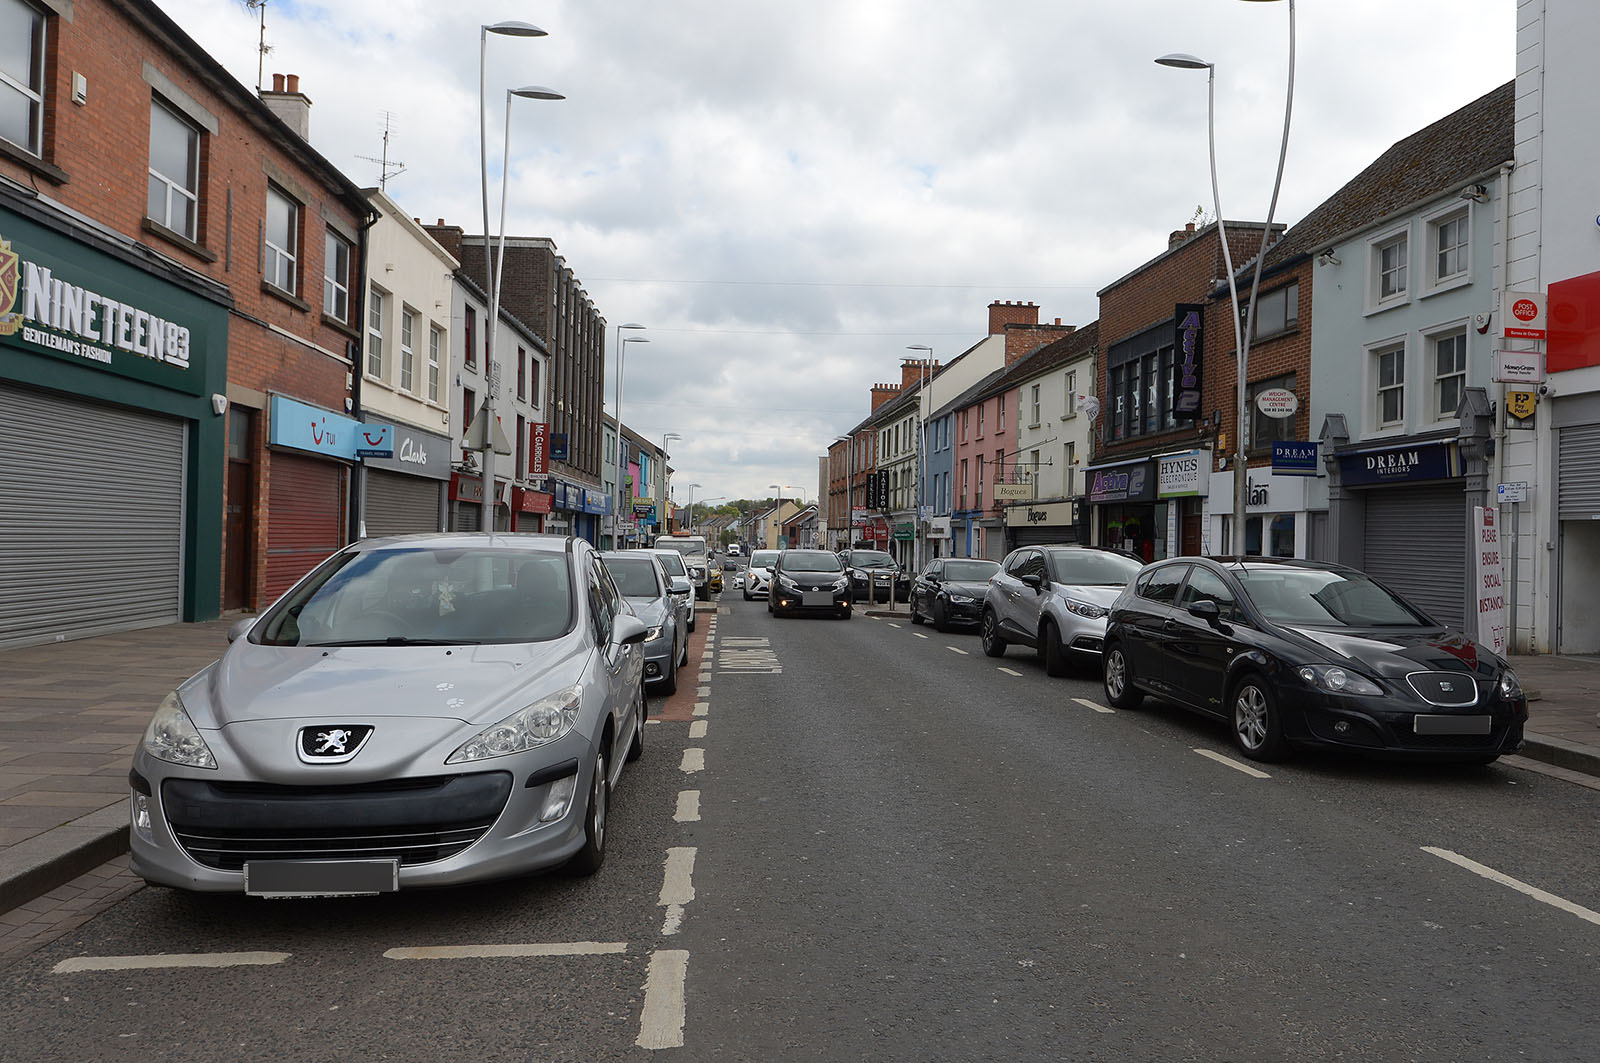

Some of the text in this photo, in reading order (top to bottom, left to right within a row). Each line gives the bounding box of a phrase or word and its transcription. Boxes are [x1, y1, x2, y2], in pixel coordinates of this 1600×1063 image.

[22, 261, 190, 362] NINETEEN83
[1514, 309, 1535, 317] OFFICE
[23, 327, 112, 364] GENTLEMAN'S FASHION
[1176, 311, 1200, 412] Active 2
[326, 432, 336, 445] TUI
[399, 438, 427, 465] Clarks
[1276, 448, 1314, 456] DREAM
[1161, 459, 1198, 474] HYNES
[1366, 451, 1419, 469] DREAM
[1376, 465, 1411, 474] INTERIORS
[1091, 470, 1128, 495] Active
[1160, 472, 1197, 484] ELECTRONIQUE
[1000, 487, 1027, 496] Bogues
[1027, 508, 1048, 525] Bogues
[1482, 529, 1497, 543] PLEASE
[1482, 552, 1499, 566] ENSURE
[1484, 574, 1501, 588] SOCIAL
